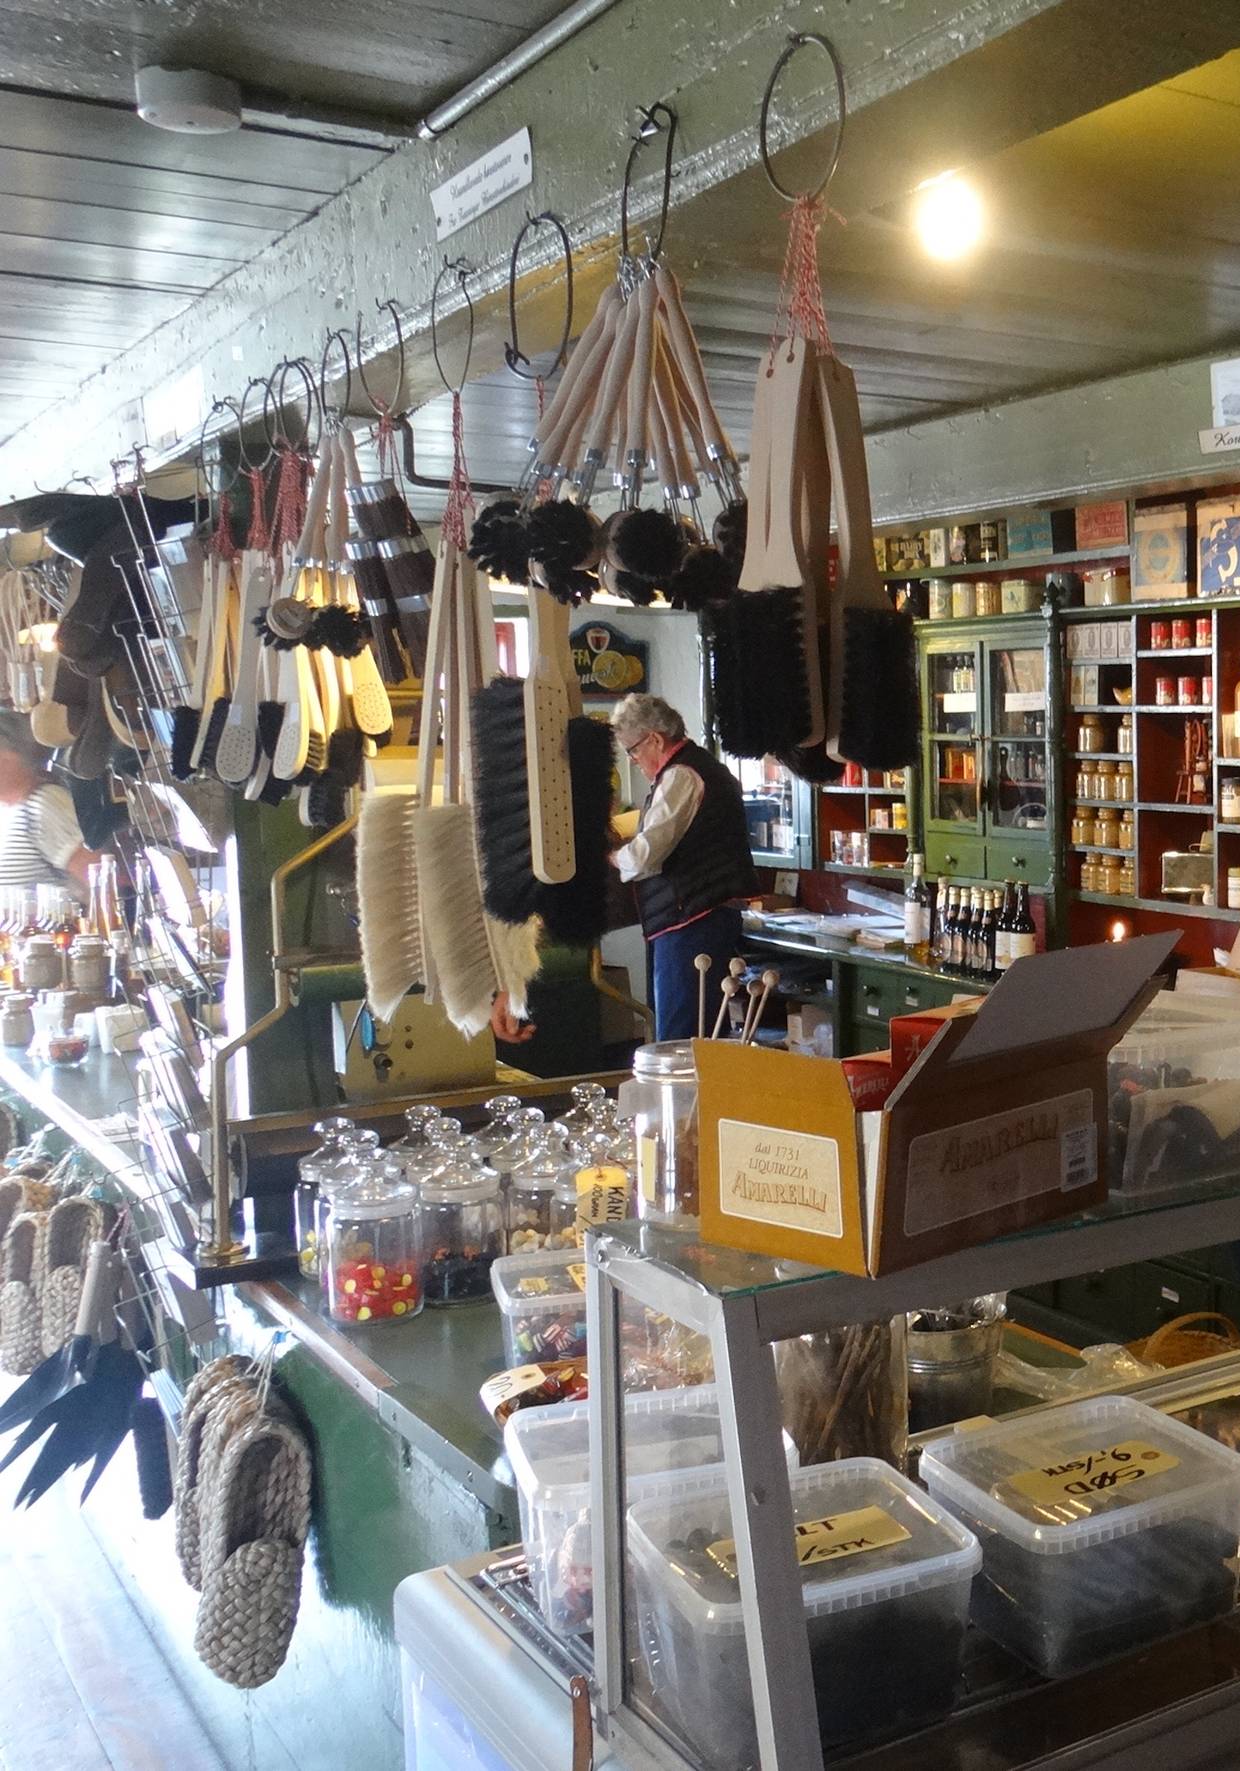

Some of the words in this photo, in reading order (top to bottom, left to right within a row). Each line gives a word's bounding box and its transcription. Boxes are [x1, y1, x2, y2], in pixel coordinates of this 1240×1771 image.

[755, 1142, 771, 1155] dal
[775, 1145, 800, 1161] 1731
[748, 1158, 809, 1180] LIQUIRIZIA
[796, 1519, 837, 1537] LT
[802, 1538, 875, 1562] /STK
